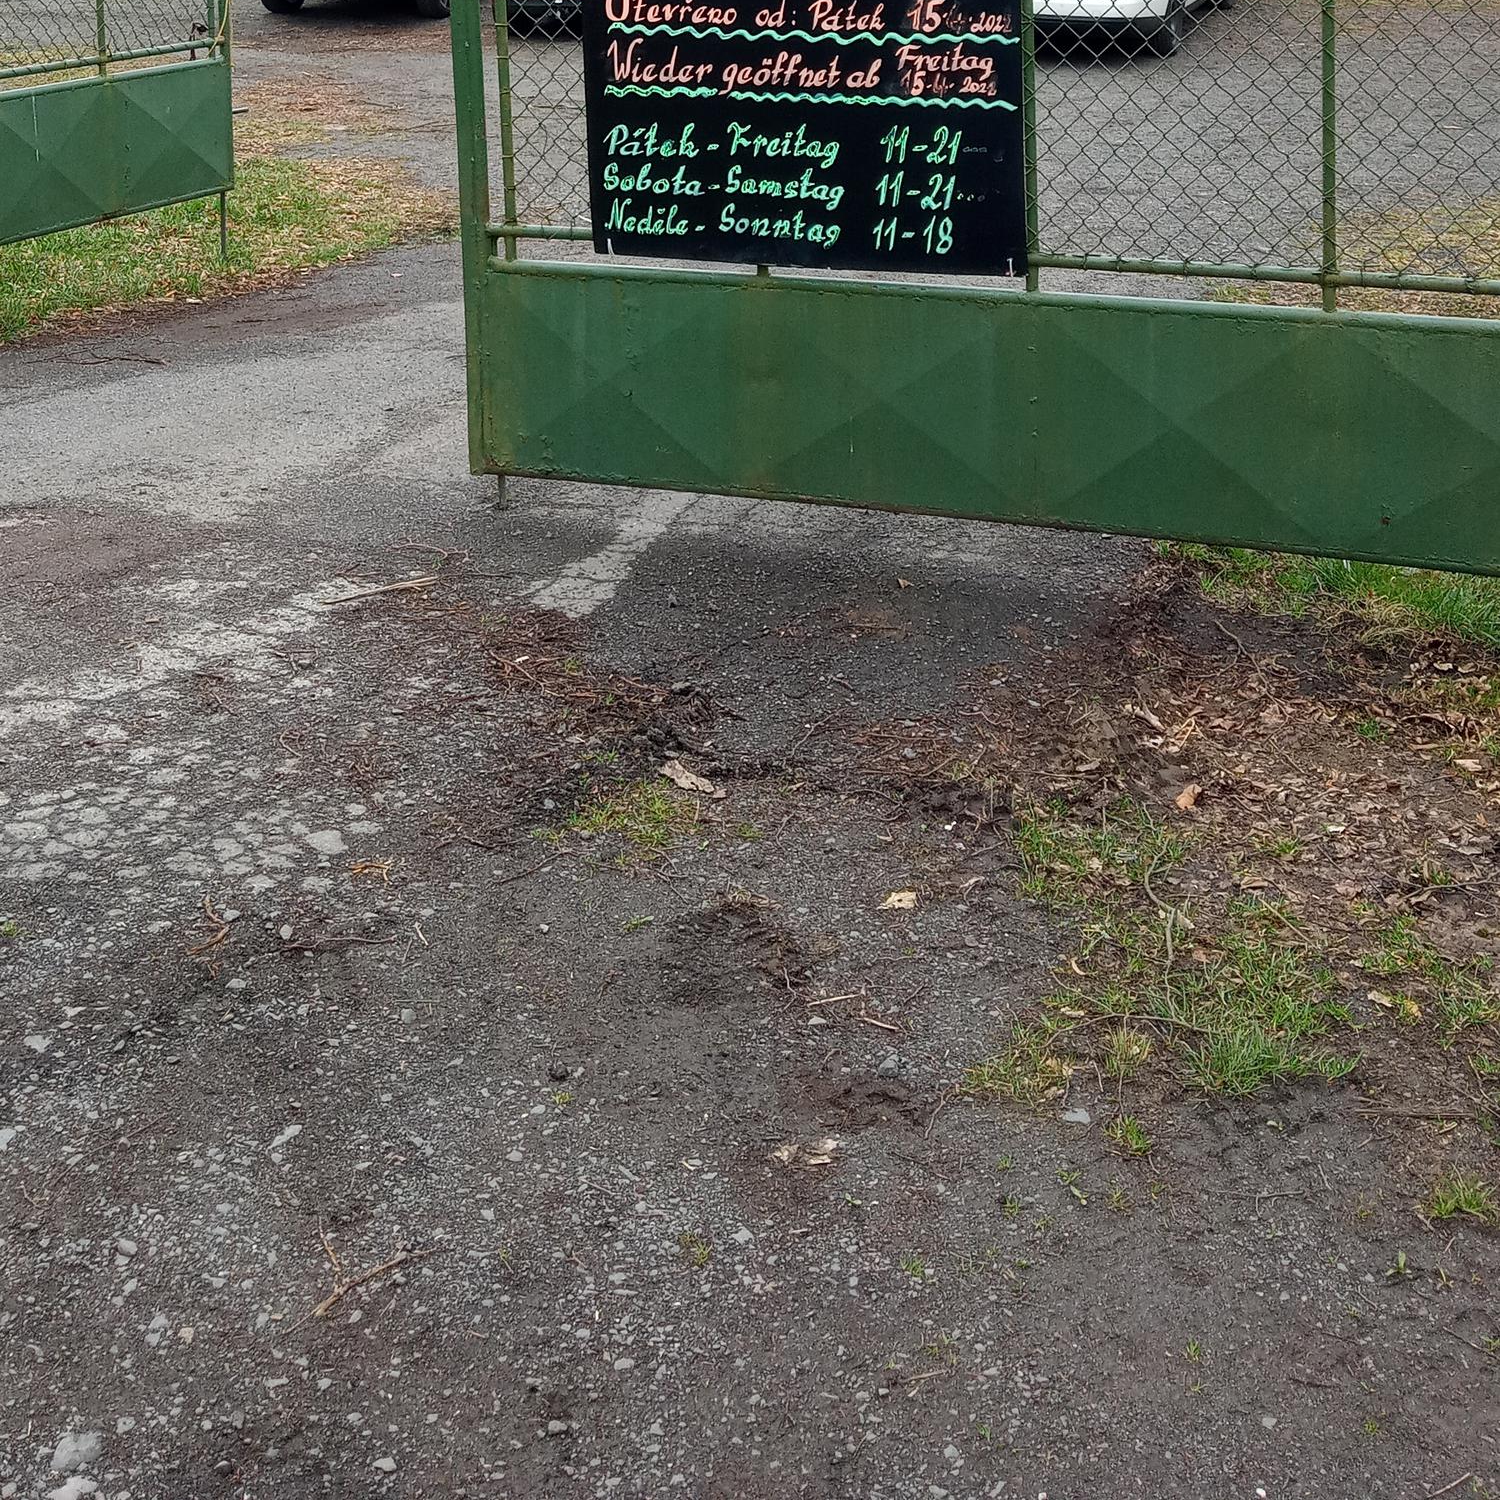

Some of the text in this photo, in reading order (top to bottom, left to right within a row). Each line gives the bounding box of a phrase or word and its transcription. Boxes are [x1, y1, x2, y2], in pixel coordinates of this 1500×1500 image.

[607, 38, 994, 96] Wieder geöffnet ab Freitag
[603, 122, 699, 158] Pátek
[727, 121, 840, 169] Freitag
[603, 162, 705, 196] Sobota
[725, 164, 845, 211] Samstag
[604, 197, 689, 235] Neděle
[718, 202, 841, 250] Sonntag
